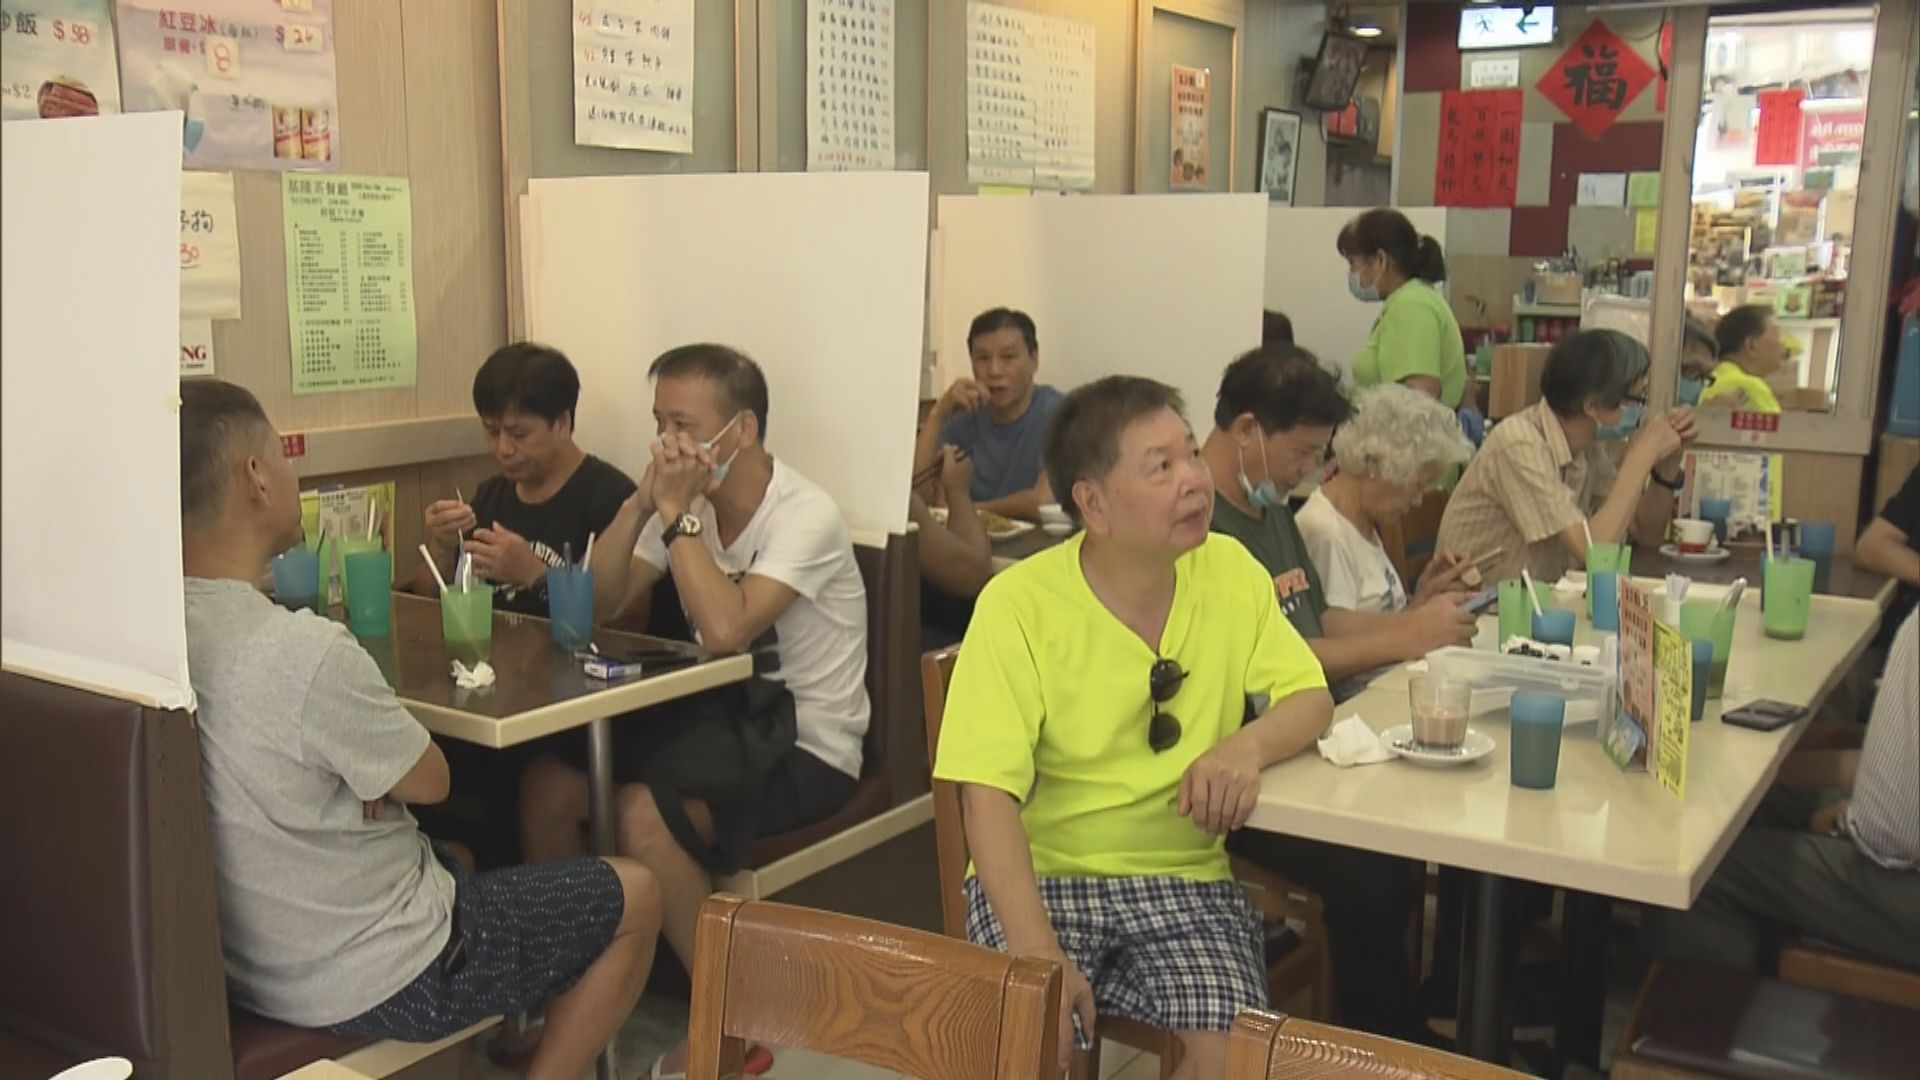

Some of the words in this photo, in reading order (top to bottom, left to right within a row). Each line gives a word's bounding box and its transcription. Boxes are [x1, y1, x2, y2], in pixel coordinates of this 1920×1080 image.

[159, 9, 217, 35] 紅豆冰
[1563, 46, 1628, 109] 福
[180, 345, 207, 361] NG
